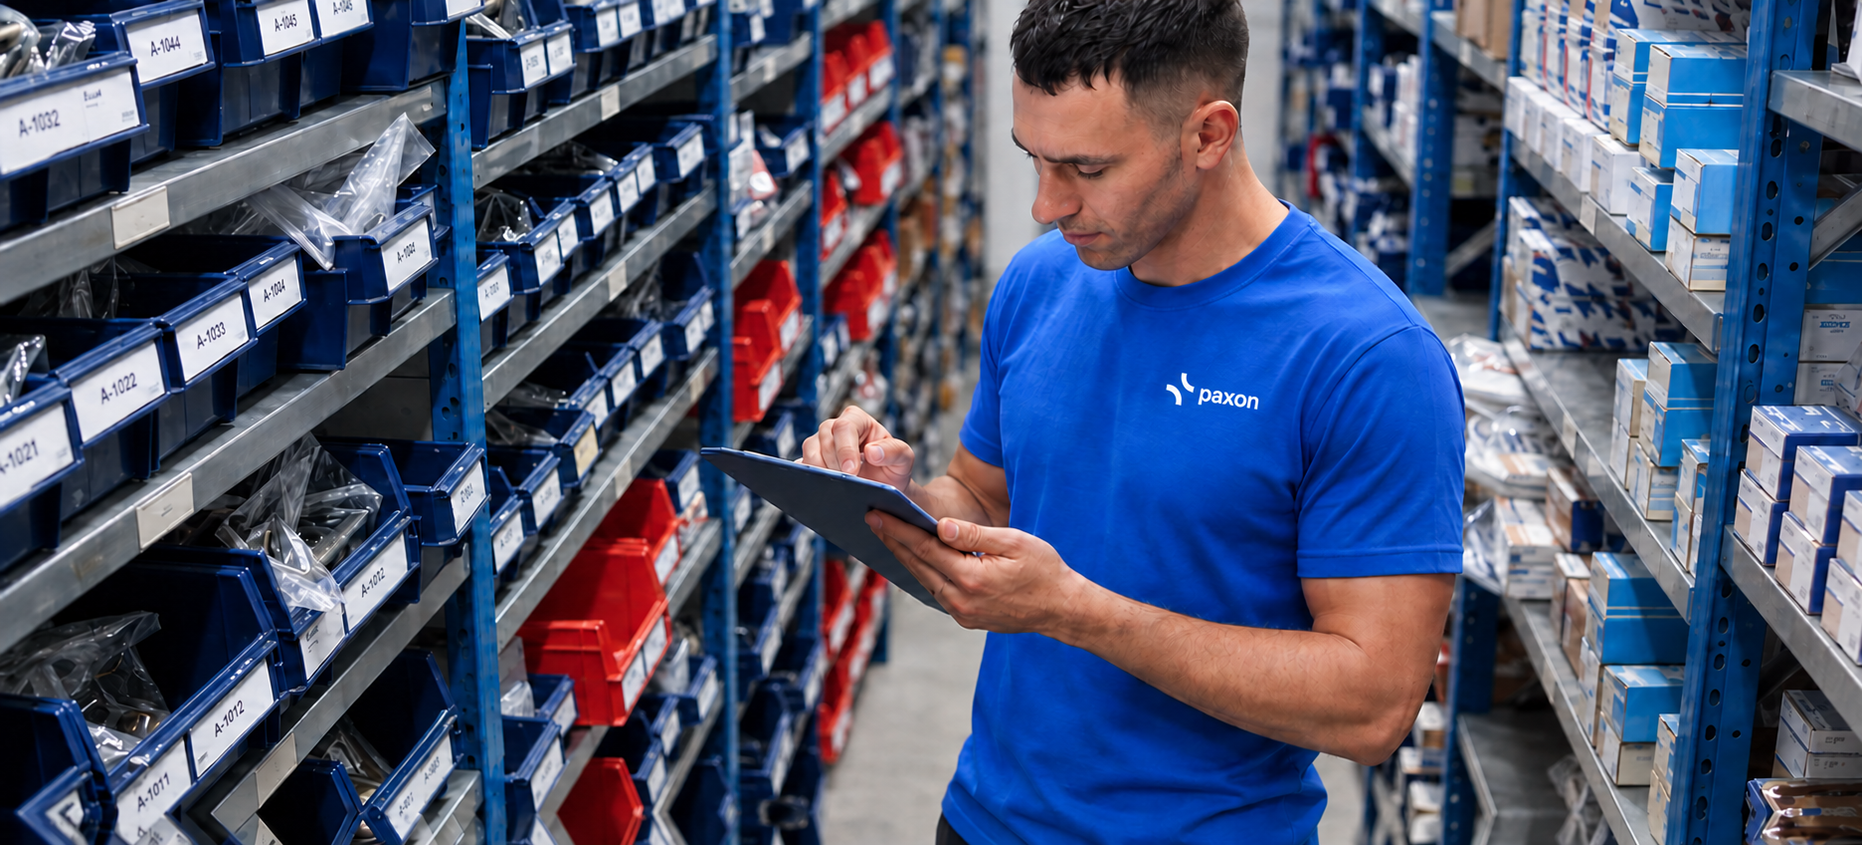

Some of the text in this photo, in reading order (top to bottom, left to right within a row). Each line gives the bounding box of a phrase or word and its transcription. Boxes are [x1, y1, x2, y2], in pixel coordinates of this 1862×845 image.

[274, 14, 298, 32] A-1045
[150, 35, 181, 57] A-1044
[19, 109, 61, 137] A-1032
[197, 321, 227, 350] A-1033
[101, 372, 138, 405] A-1022
[1198, 388, 1260, 410] paxon
[214, 699, 245, 738] A-1012
[137, 772, 170, 812] A-1011
